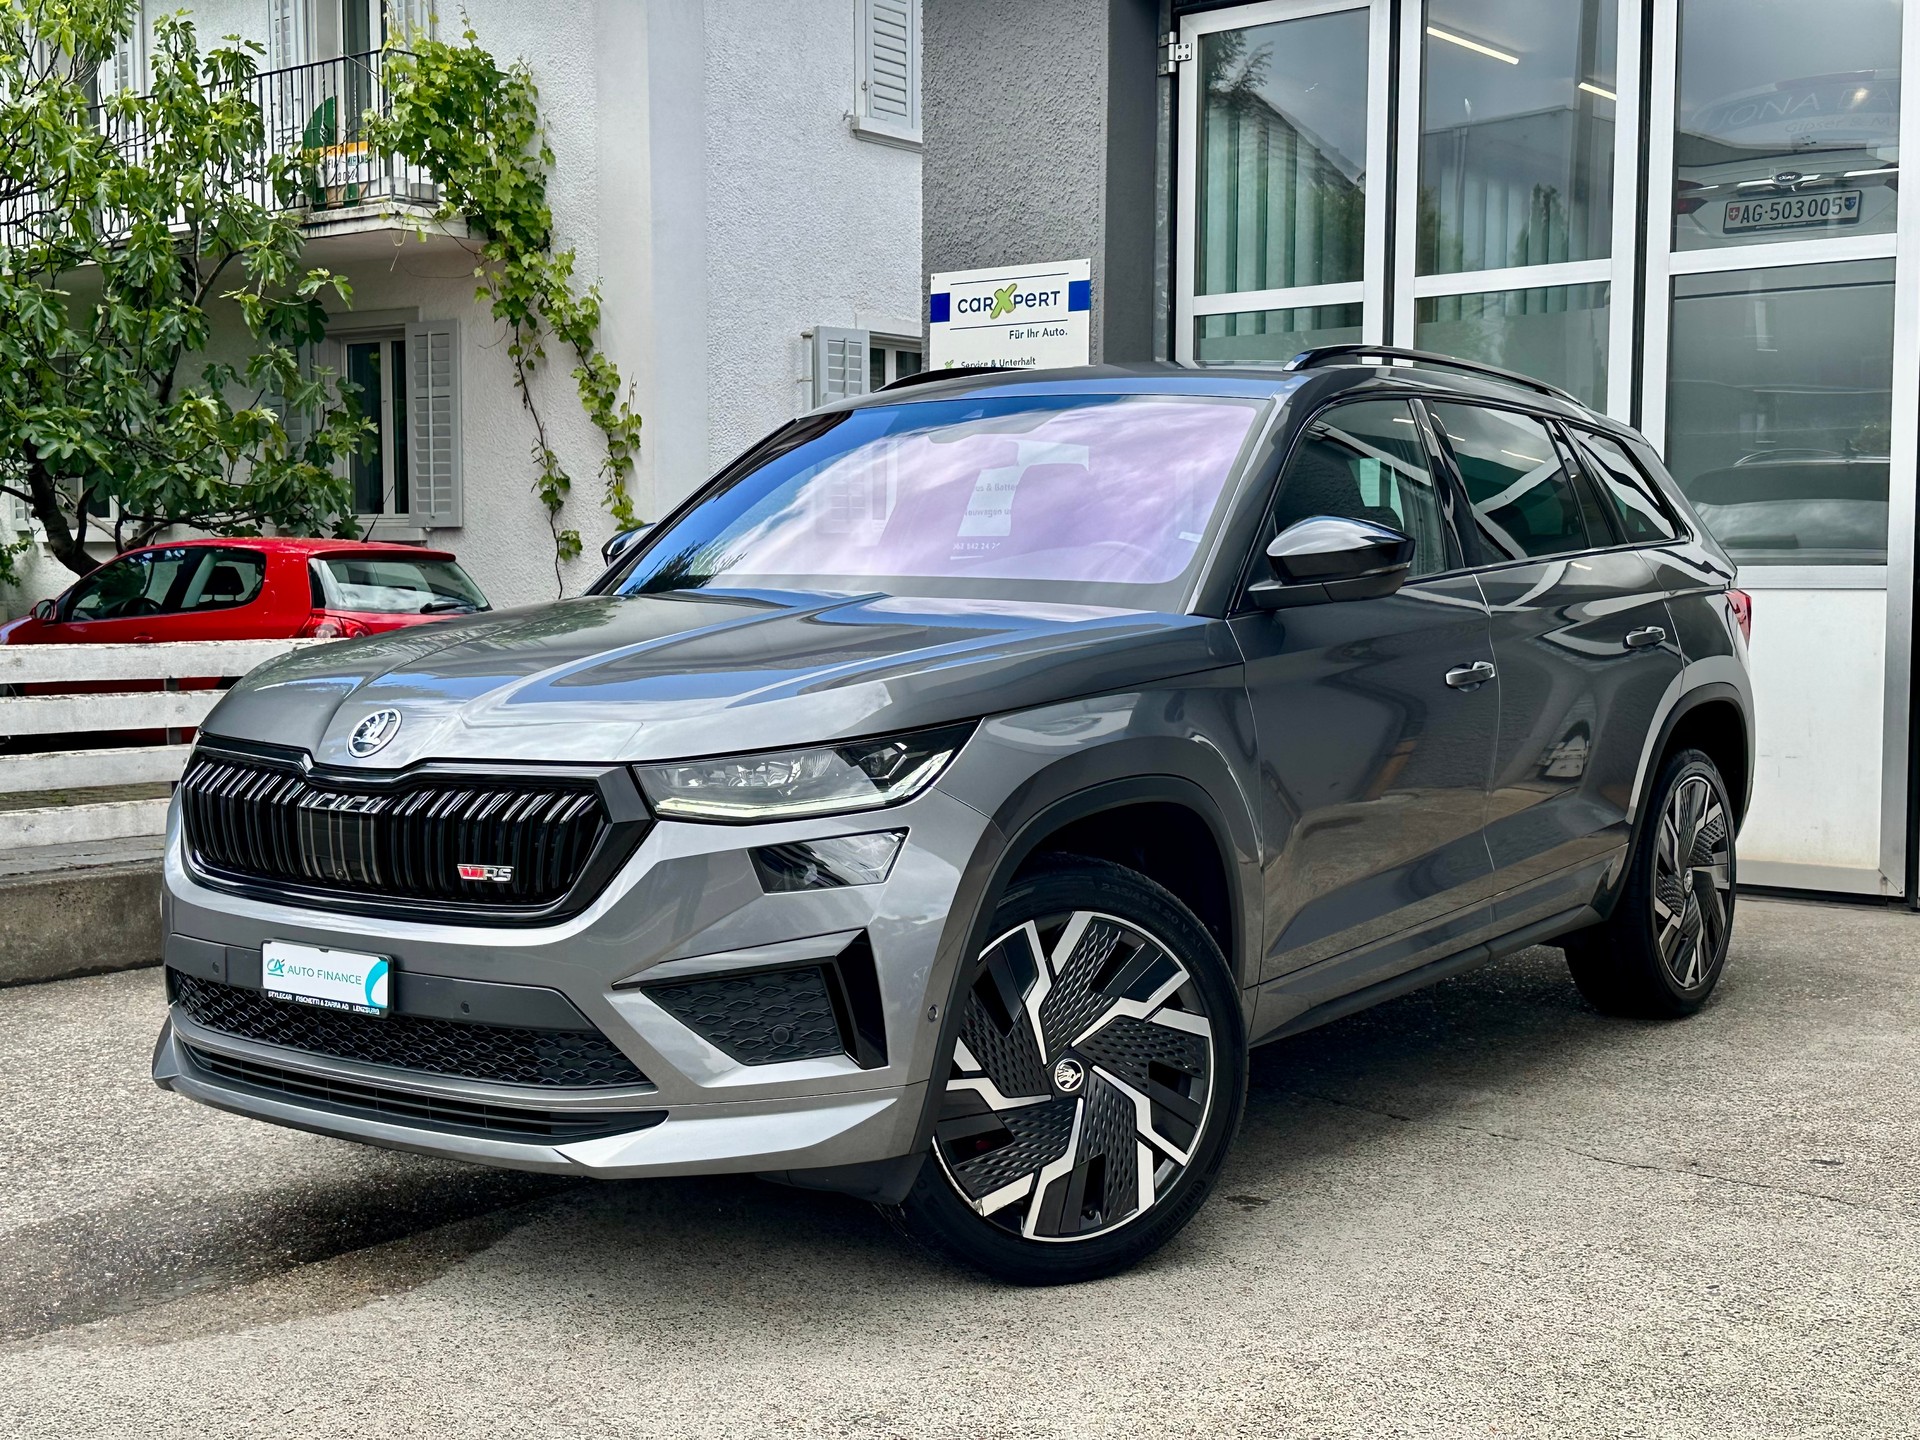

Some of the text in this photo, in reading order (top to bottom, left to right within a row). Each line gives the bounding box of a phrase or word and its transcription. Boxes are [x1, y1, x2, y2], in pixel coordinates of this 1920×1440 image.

[1009, 327, 1068, 340] Für Ihr Auto.
[960, 359, 991, 368] Service
[999, 357, 1036, 367] Unterhalt
[287, 965, 315, 977] AUTO
[317, 969, 362, 985] FINANCE
